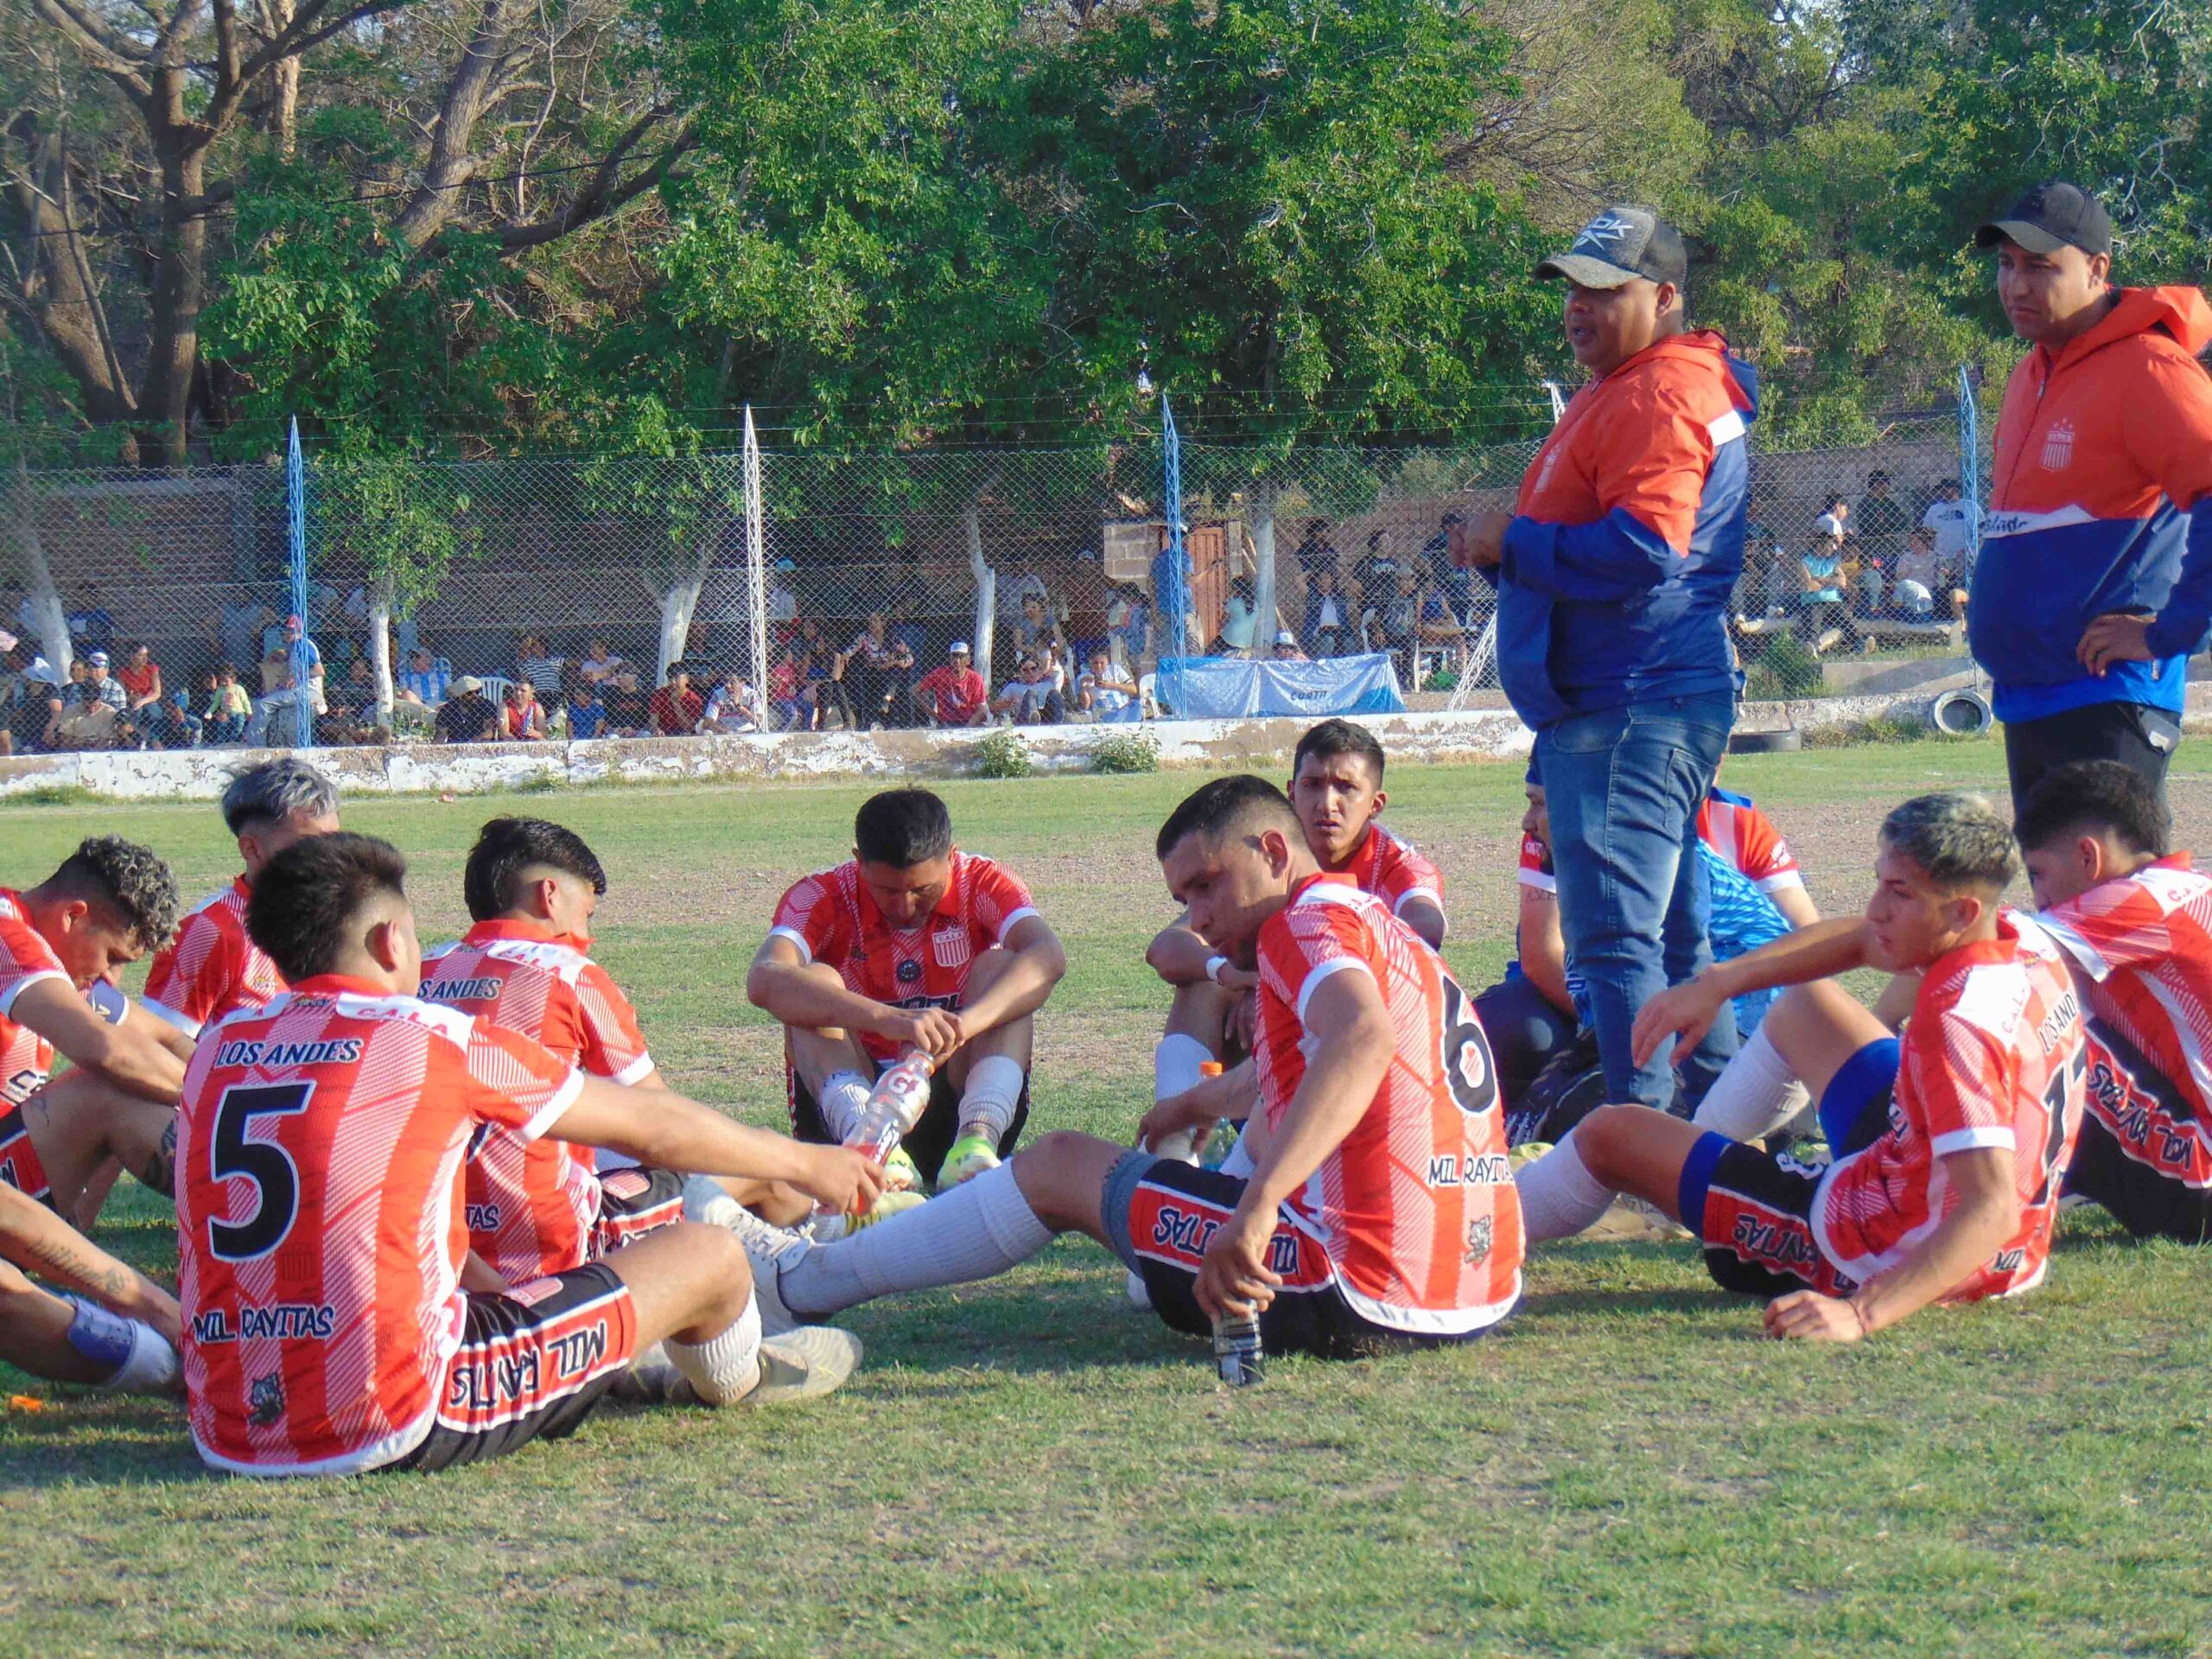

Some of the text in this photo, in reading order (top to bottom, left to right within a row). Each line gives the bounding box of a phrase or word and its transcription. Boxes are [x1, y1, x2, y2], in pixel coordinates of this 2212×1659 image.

[433, 977, 504, 1000] ANDES
[2053, 992, 2078, 1032] AND
[215, 1038, 365, 1068] LOS ANDES
[1440, 969, 1499, 1118] 6
[207, 1079, 317, 1262] 5
[1427, 1155, 1461, 1186] MIL
[194, 1300, 337, 1344] MIL RAYITAS
[546, 1319, 609, 1381] MIL
